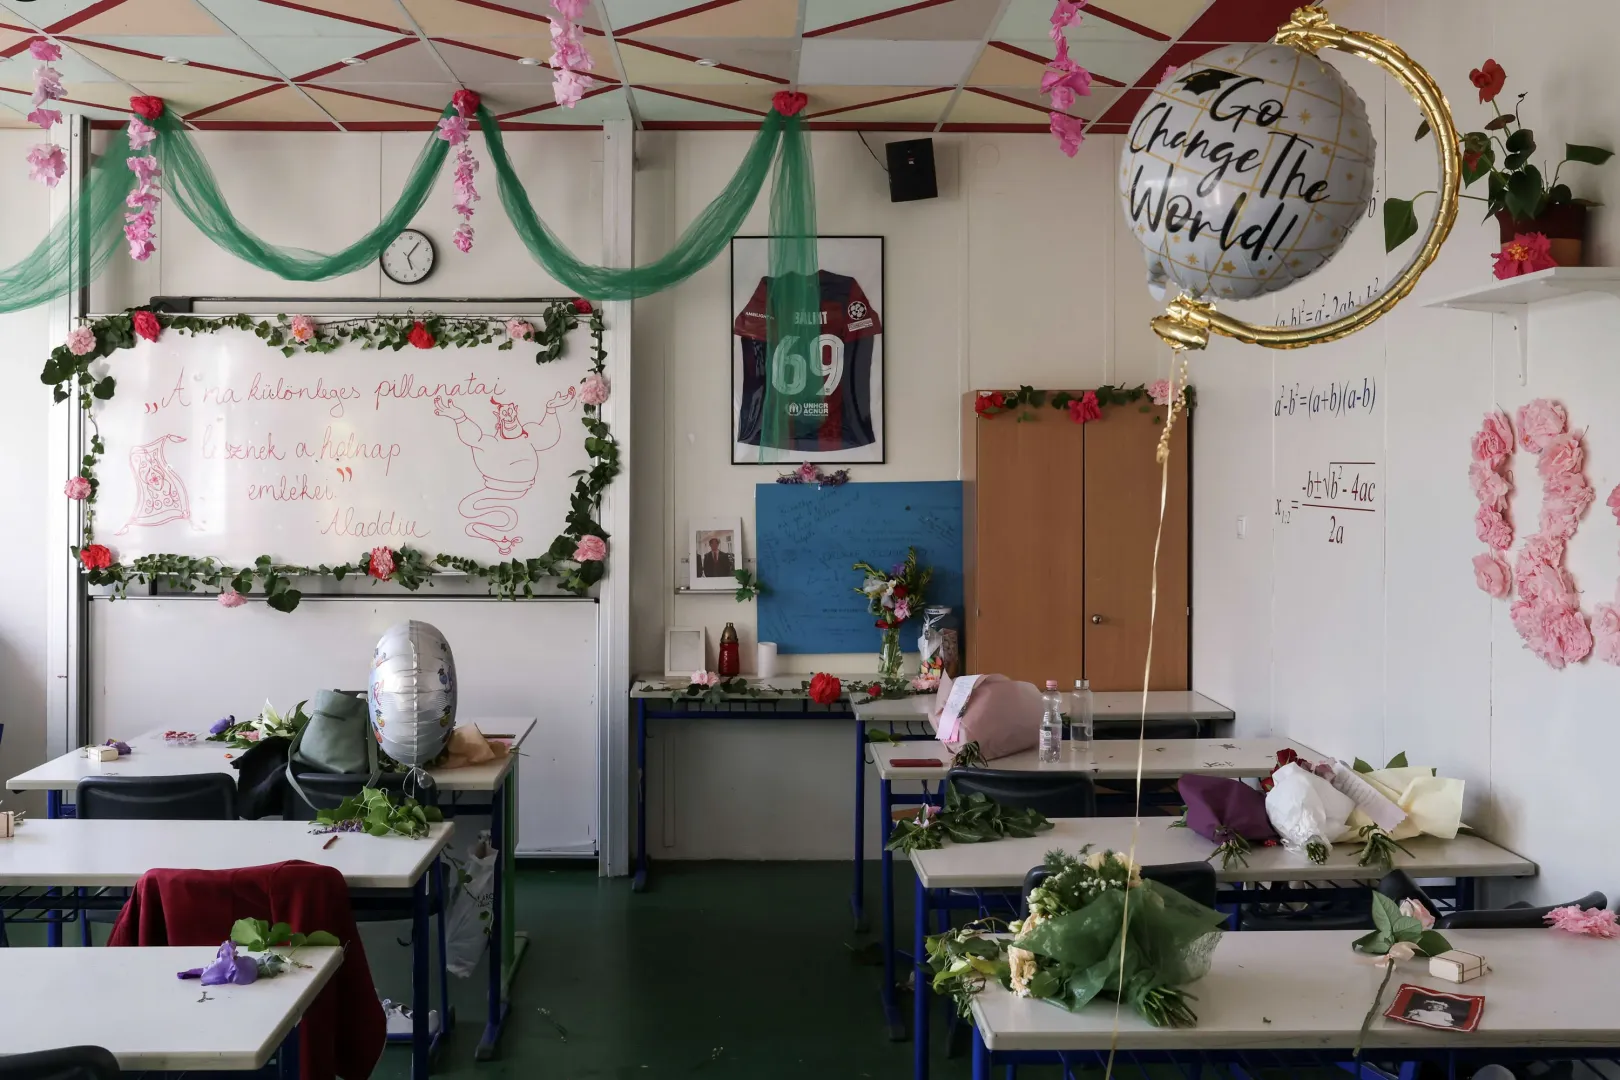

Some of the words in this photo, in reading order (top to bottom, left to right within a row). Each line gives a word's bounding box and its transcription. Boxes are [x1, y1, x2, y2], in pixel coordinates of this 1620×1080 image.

[1209, 77, 1288, 132] Go
[1130, 102, 1262, 198] Change
[1267, 131, 1330, 203] The
[1131, 163, 1298, 261] World!
[771, 333, 845, 396] 69
[248, 372, 361, 418] különleges
[374, 372, 506, 411] pillanatai
[295, 442, 316, 458] a
[1328, 515, 1344, 544] 2a
